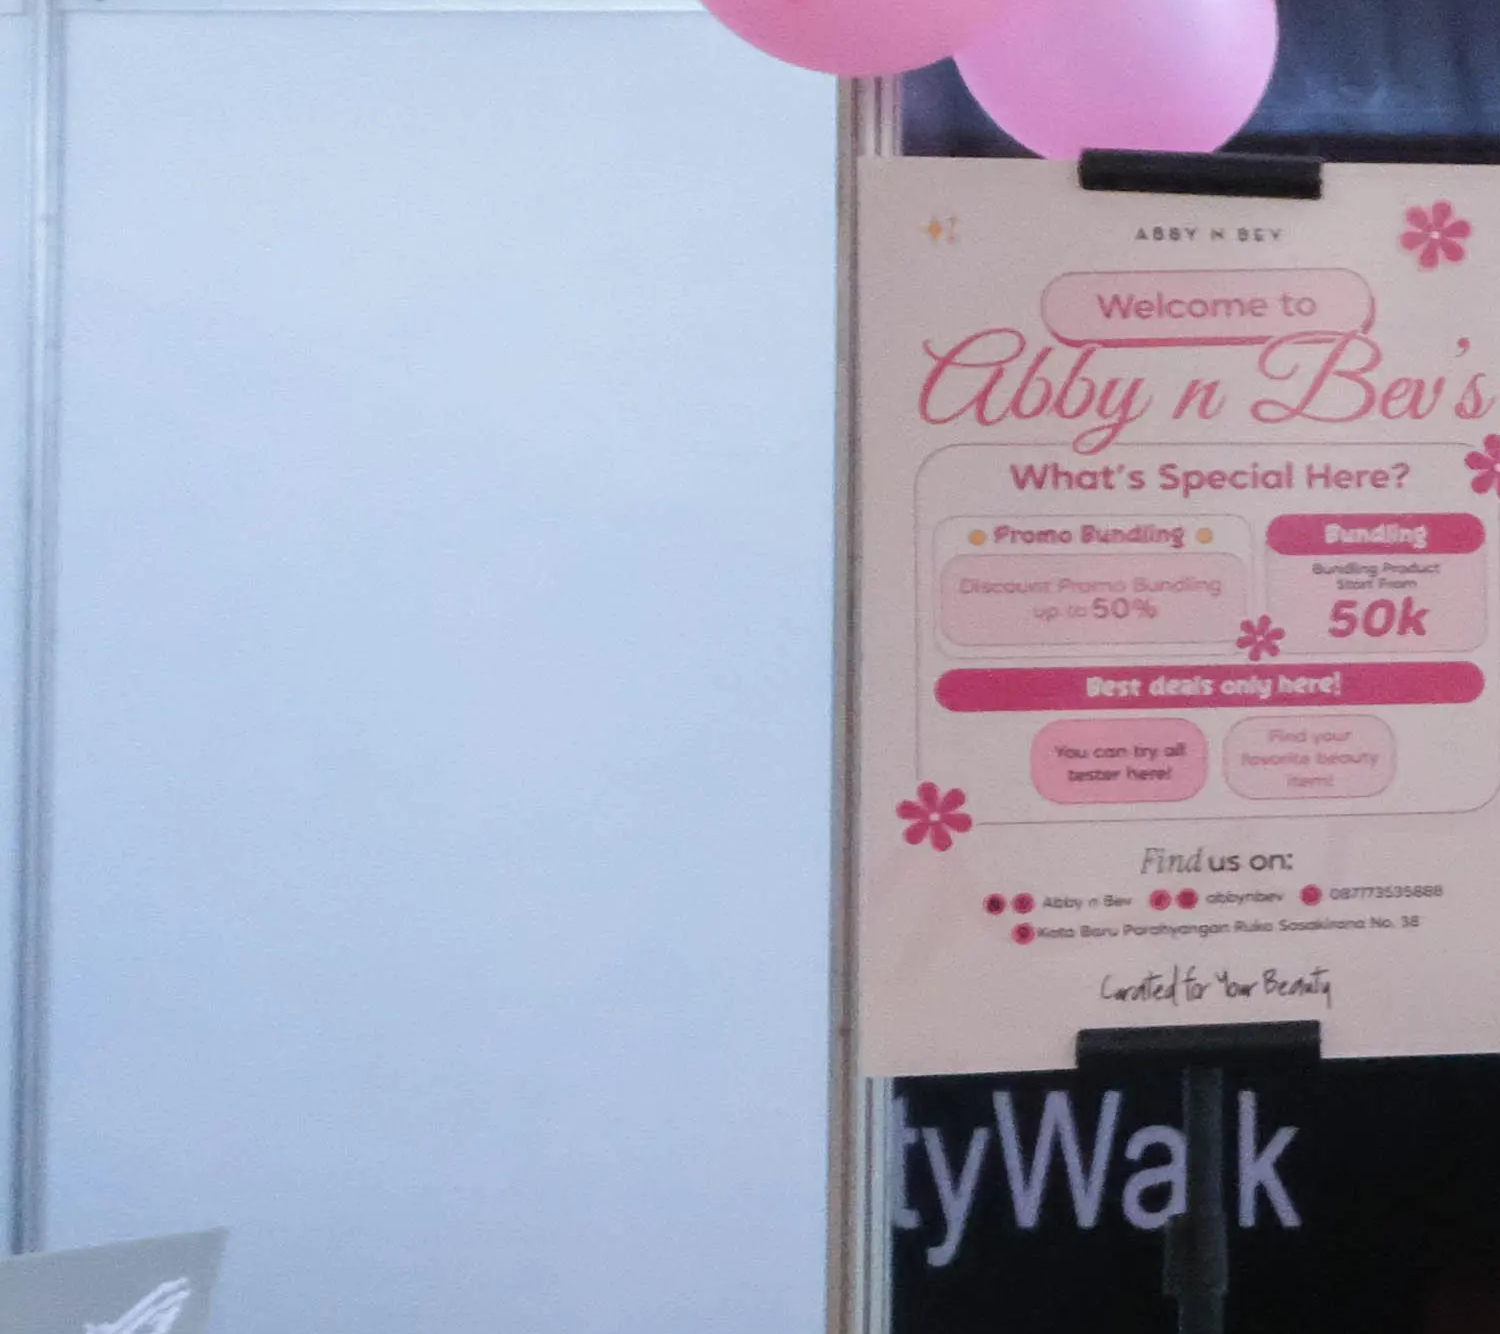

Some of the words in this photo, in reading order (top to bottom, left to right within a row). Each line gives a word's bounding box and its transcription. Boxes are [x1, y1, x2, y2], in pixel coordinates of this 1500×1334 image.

[1135, 227, 1197, 242] ABBY
[1211, 228, 1225, 241] N
[1096, 292, 1269, 320] Welcome
[1280, 292, 1318, 319] to
[918, 327, 1154, 456] Abby
[1171, 372, 1226, 420] n
[1249, 328, 1497, 424] Bev's
[1009, 462, 1146, 492] What's
[1156, 462, 1295, 499] Special
[1305, 462, 1411, 491] Here?
[993, 524, 1073, 545] Promo
[1080, 523, 1186, 549] Bundling
[1323, 522, 1429, 549] Bundling
[1311, 562, 1378, 577] Bundling
[1381, 561, 1441, 575] Product
[959, 578, 1051, 595] Discount
[1057, 577, 1127, 594] Promo
[1133, 576, 1223, 596] Bundling
[1033, 605, 1059, 622] up
[1067, 604, 1087, 619] to
[1091, 596, 1159, 620] 50%
[1328, 595, 1432, 638] 50k
[1086, 676, 1141, 697] Best
[1149, 675, 1213, 696] deals
[1219, 675, 1273, 699] only
[1278, 671, 1343, 695] here!
[1268, 729, 1308, 743] Find
[1312, 729, 1352, 746] your
[1053, 744, 1087, 759] You
[1093, 745, 1128, 759] can
[1133, 744, 1158, 762] try
[1164, 742, 1187, 757] all
[1241, 750, 1310, 766] favorite
[1315, 749, 1380, 768] beauty
[1126, 765, 1174, 781] here!
[1140, 845, 1204, 875] Find
[1207, 853, 1241, 873] us
[1248, 852, 1294, 872] on:
[1042, 896, 1084, 911] Abby
[1087, 896, 1099, 907] n
[1102, 894, 1134, 907] Bev
[1205, 889, 1285, 907] abbynbev
[1037, 926, 1075, 939] Kota
[1079, 924, 1118, 938] Baru
[1101, 964, 1180, 1008] Curated
[1182, 965, 1212, 1003] for
[1215, 970, 1259, 998] Your
[1262, 966, 1332, 1010] Beauty
[893, 1089, 1303, 1269] tyWak
